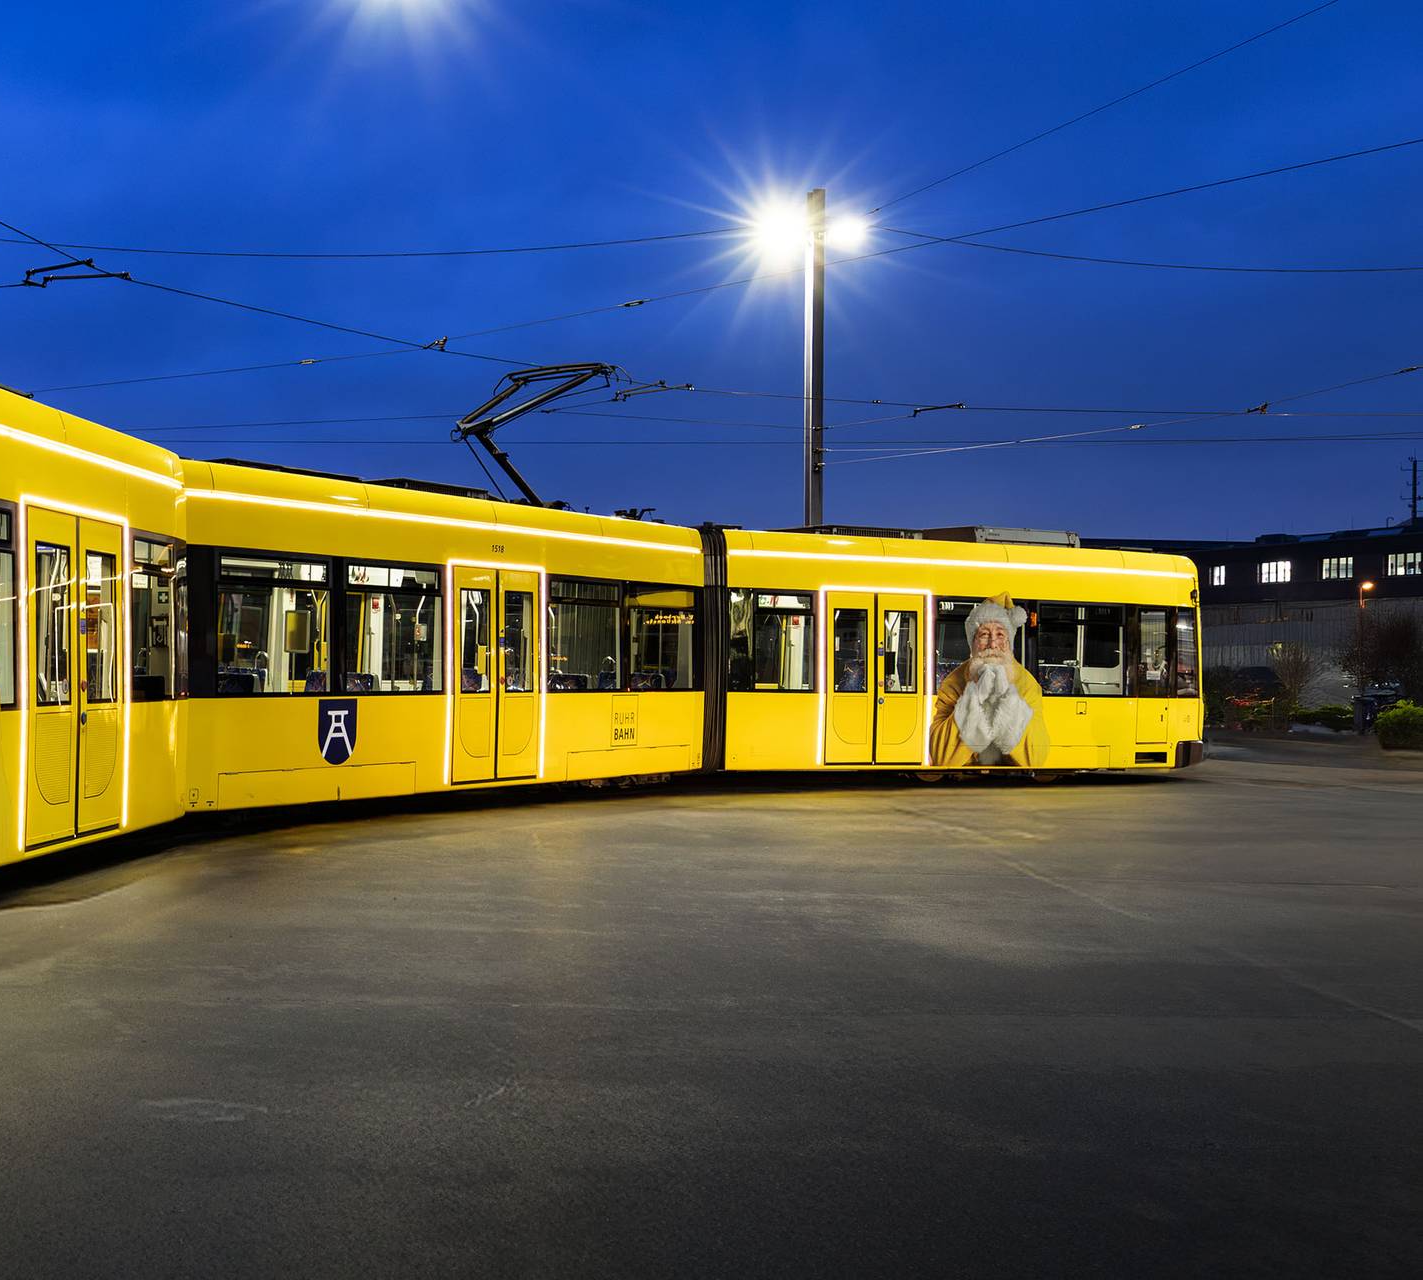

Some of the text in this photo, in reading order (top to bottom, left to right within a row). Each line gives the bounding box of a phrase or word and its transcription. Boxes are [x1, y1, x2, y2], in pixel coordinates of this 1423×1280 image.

[491, 544, 505, 554] 1518
[614, 712, 635, 725] RUHR
[614, 728, 635, 740] BAHN
